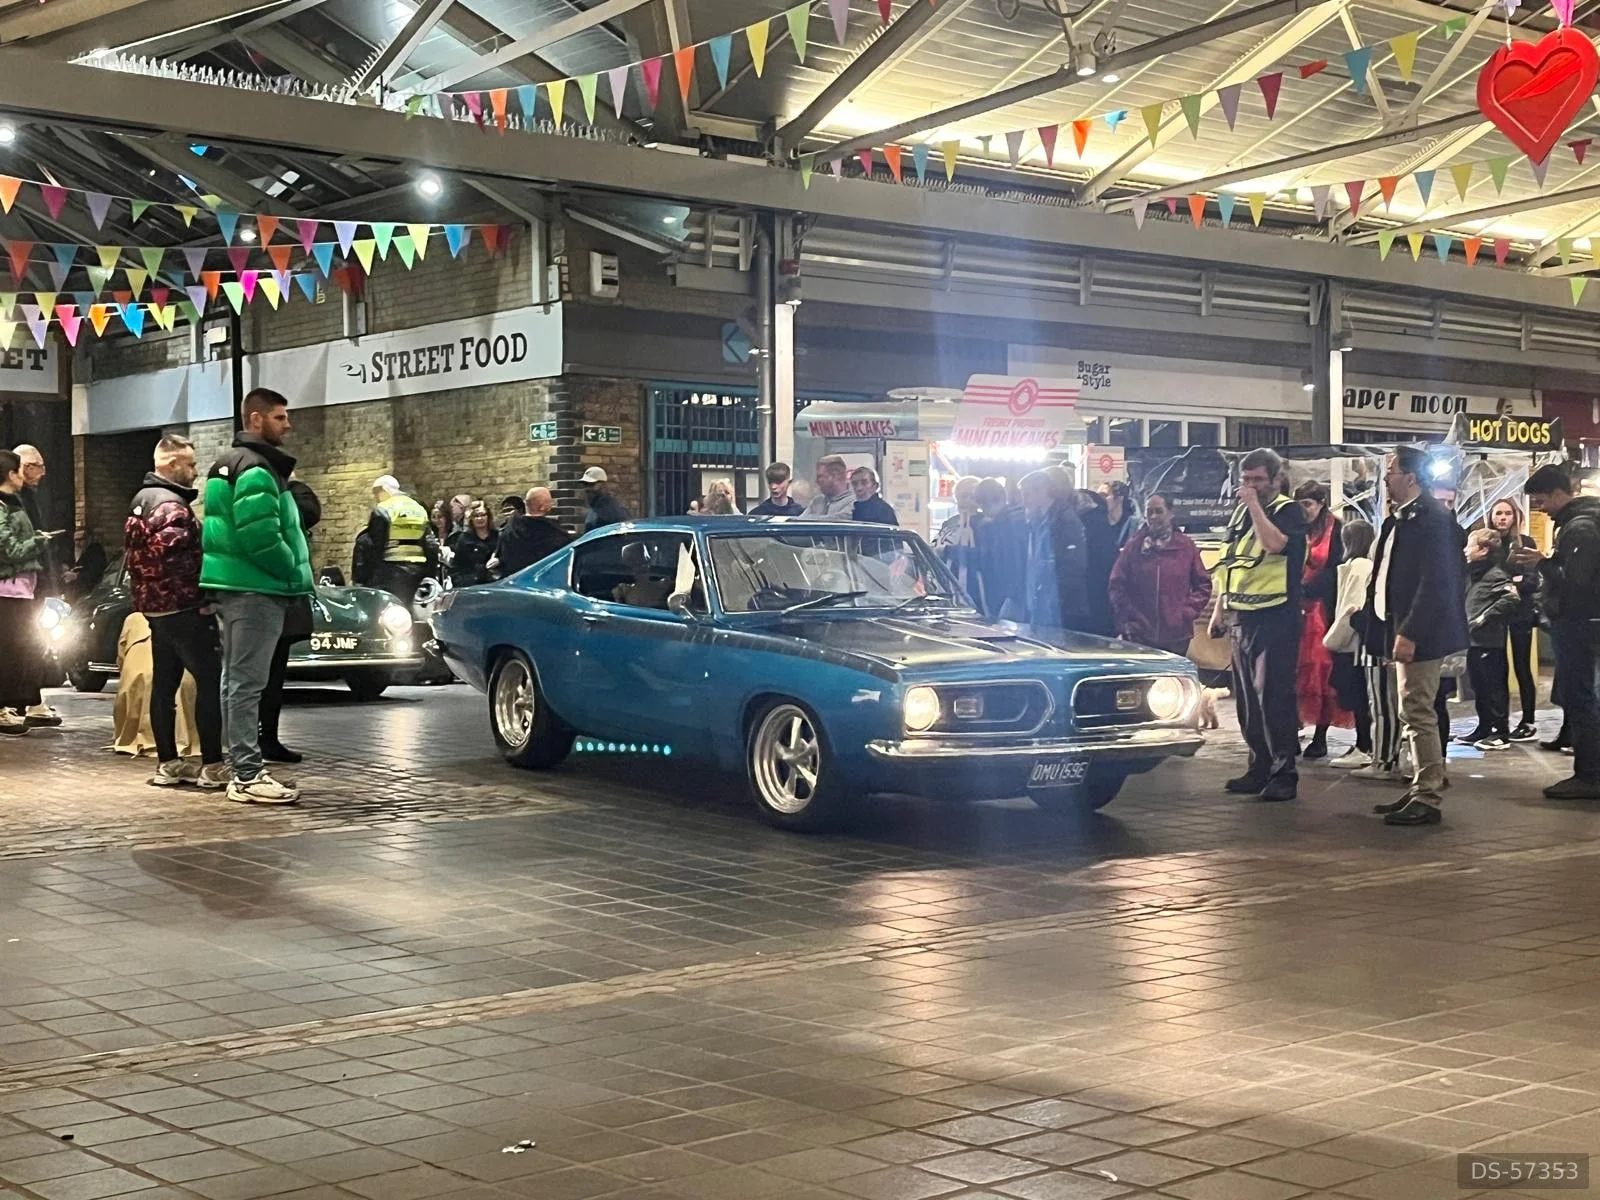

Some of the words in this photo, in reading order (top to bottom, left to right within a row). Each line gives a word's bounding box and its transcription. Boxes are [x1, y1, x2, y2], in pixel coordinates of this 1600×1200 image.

[371, 344, 455, 383] STREET
[459, 332, 528, 371] FOOD
[1078, 360, 1112, 376] Sugar
[1082, 375, 1111, 390] Style
[1410, 395, 1468, 415] moon
[809, 421, 834, 436] MINI
[836, 419, 894, 437] PANCAKES
[1470, 420, 1502, 442] HOT
[1507, 421, 1551, 444] DOGS
